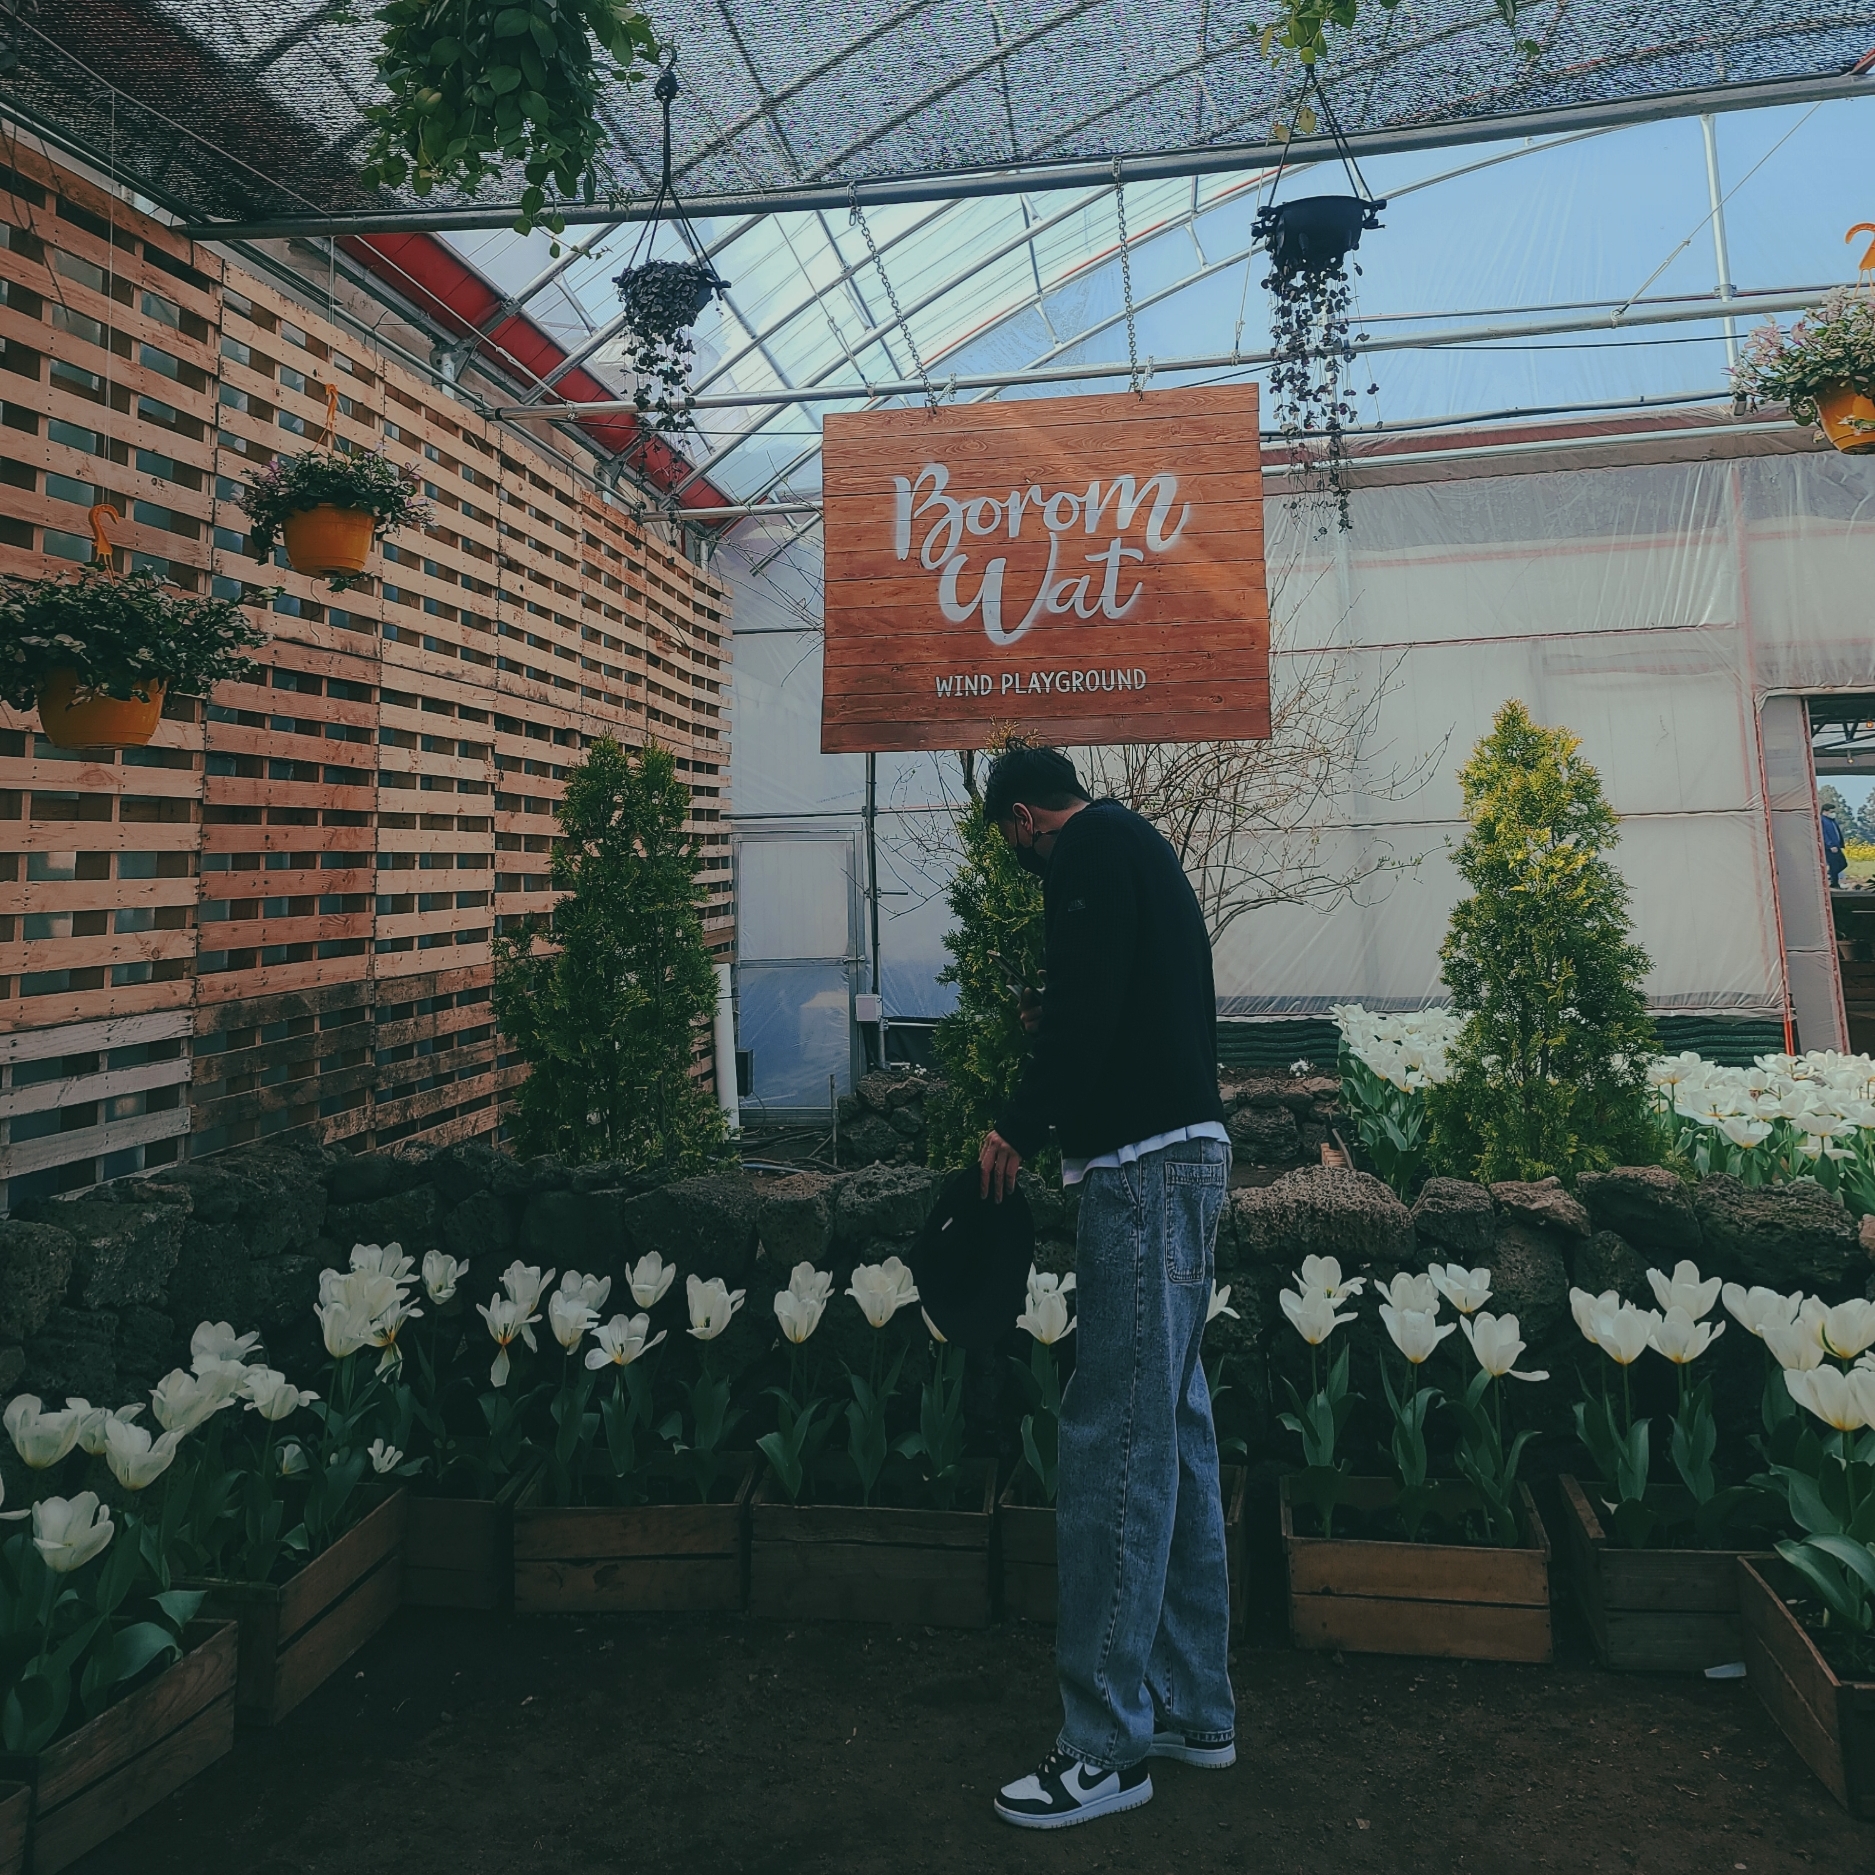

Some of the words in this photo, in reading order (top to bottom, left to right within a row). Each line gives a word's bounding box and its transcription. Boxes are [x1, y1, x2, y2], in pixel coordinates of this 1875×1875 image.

[894, 462, 1191, 570] Borom
[938, 532, 1144, 646] Wat
[935, 674, 993, 699] WIND
[1000, 668, 1148, 696] PLAYGROUND
